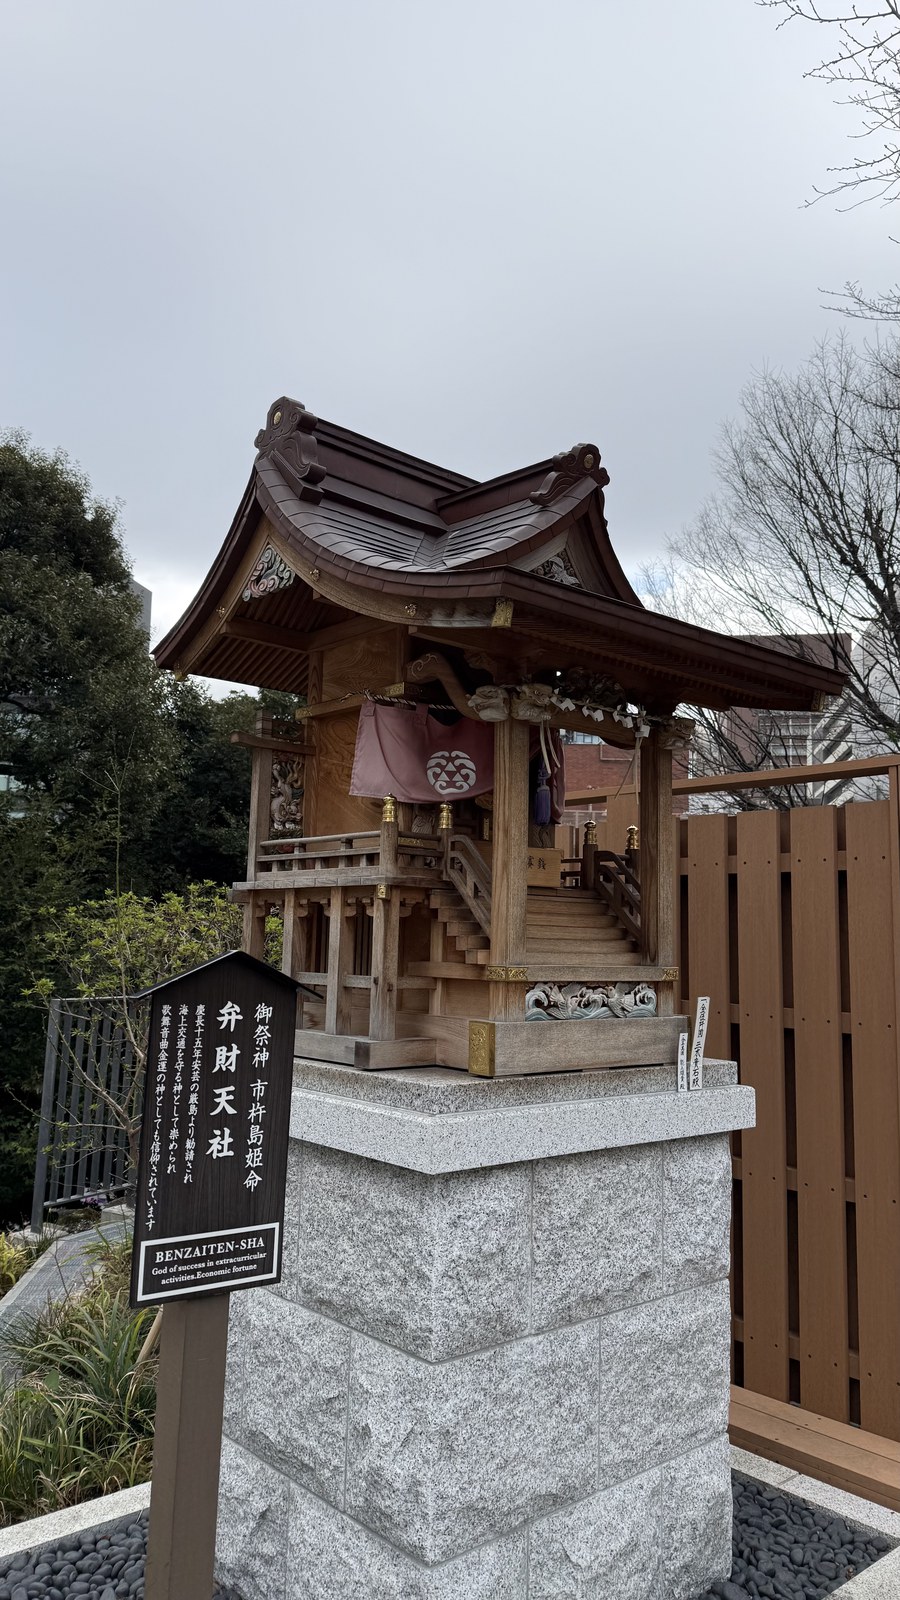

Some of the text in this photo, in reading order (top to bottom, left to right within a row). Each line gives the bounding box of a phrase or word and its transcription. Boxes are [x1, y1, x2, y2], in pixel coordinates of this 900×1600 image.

[145, 1004, 172, 1231] 歌舞音曲金運の神としても信仰されています
[166, 1004, 189, 1174] 海上交通を守る神として崇められ
[205, 1000, 244, 1160] 弁財天社
[243, 1002, 273, 1192] 御祭神 市杵島姫命
[152, 1251, 267, 1276] God of success in extracurricular
[155, 1237, 265, 1263] BENZAITEN-SHA
[232, 1263, 257, 1273] fortune
